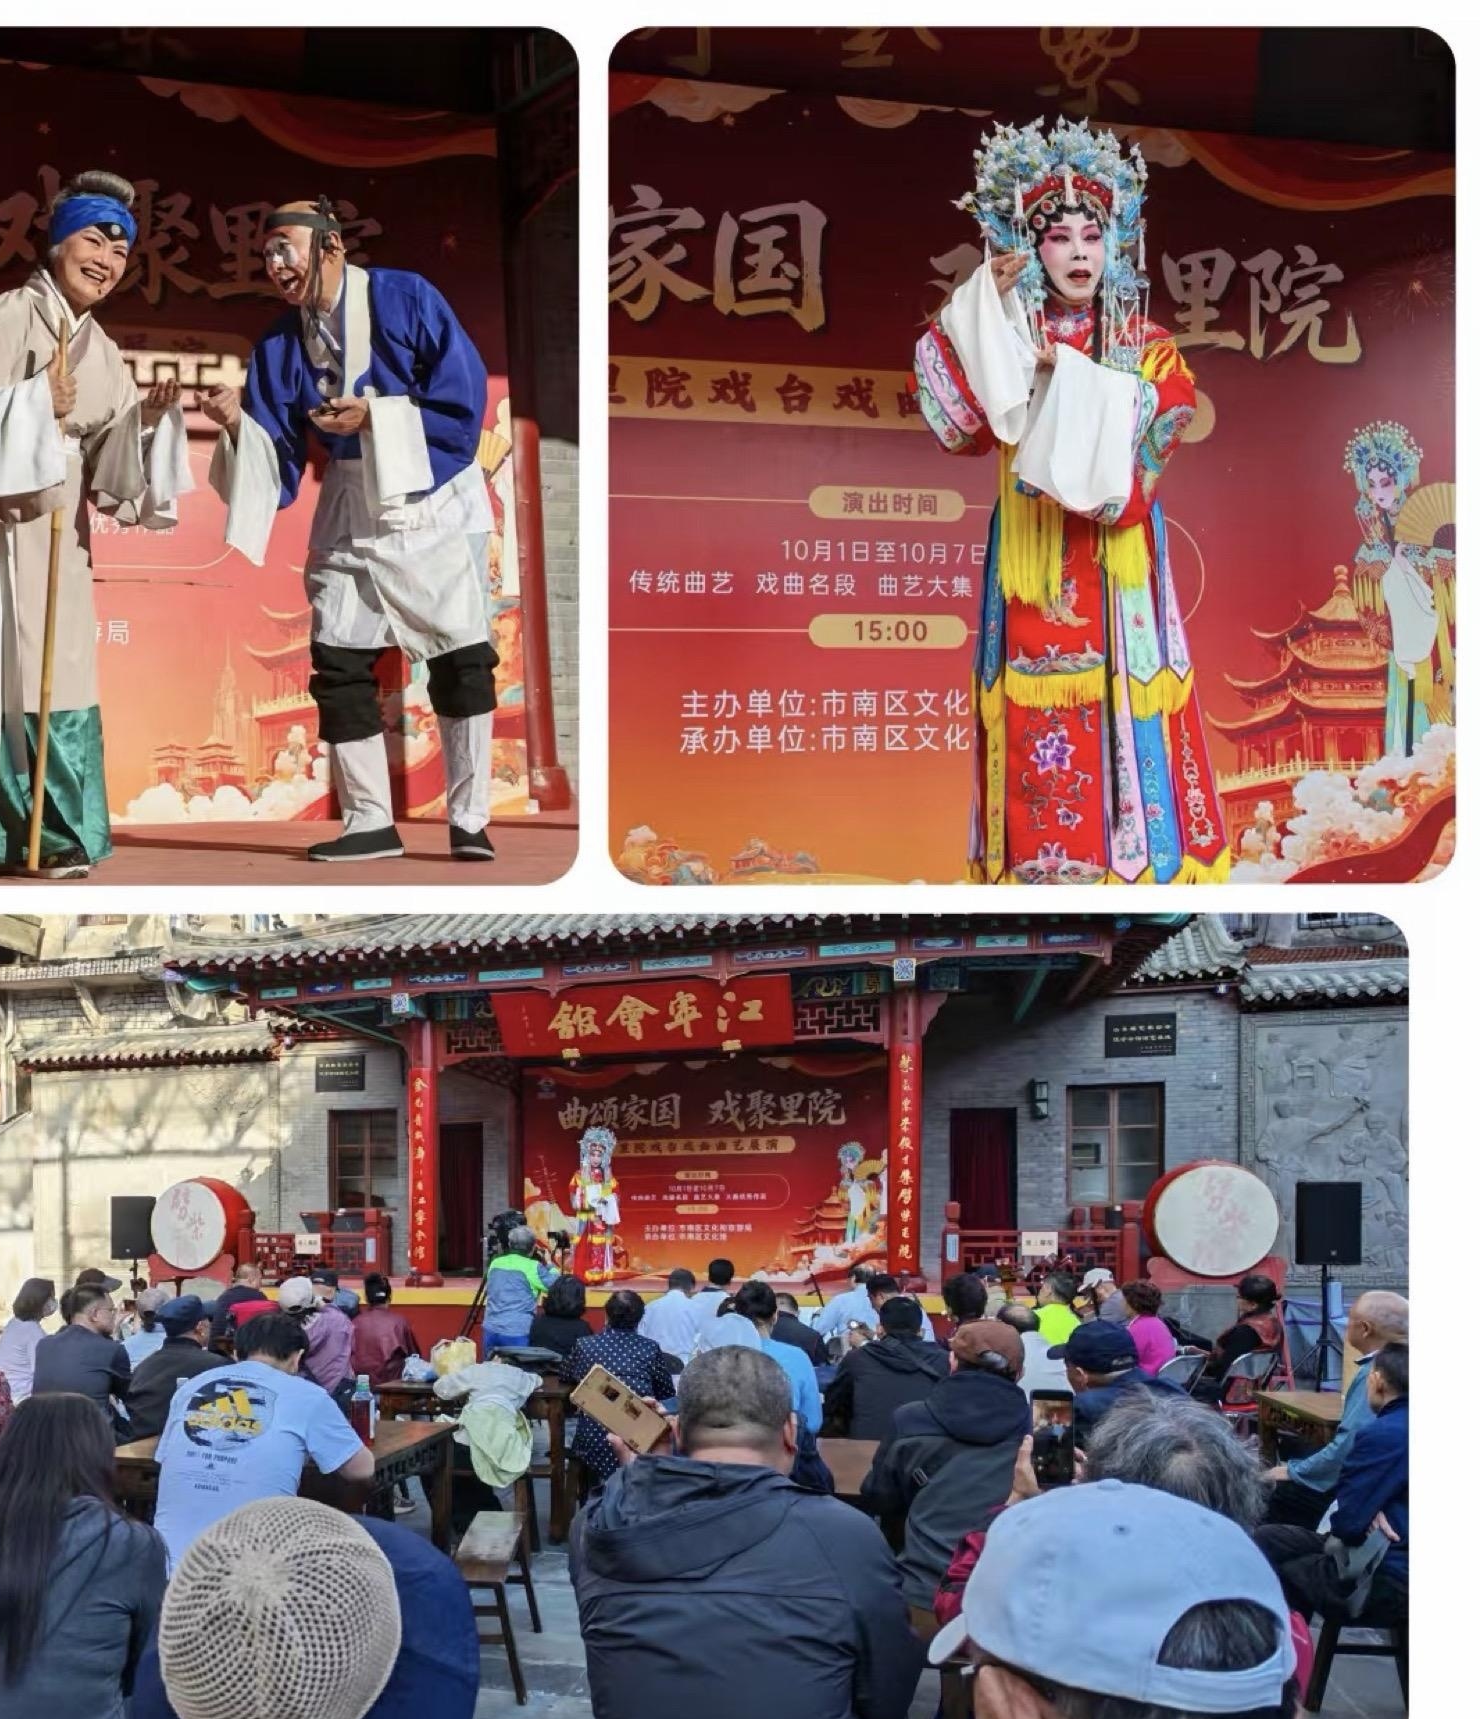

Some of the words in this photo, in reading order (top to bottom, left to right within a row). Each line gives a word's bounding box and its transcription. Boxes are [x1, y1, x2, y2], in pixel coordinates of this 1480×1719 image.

[842, 491, 939, 516] 演出时间
[629, 570, 735, 595] 传统曲艺
[756, 571, 856, 597] 戏曲名段
[878, 575, 973, 599] 曲艺大集
[854, 620, 928, 642] 15:00
[707, 1087, 847, 1132] 戏聚里院
